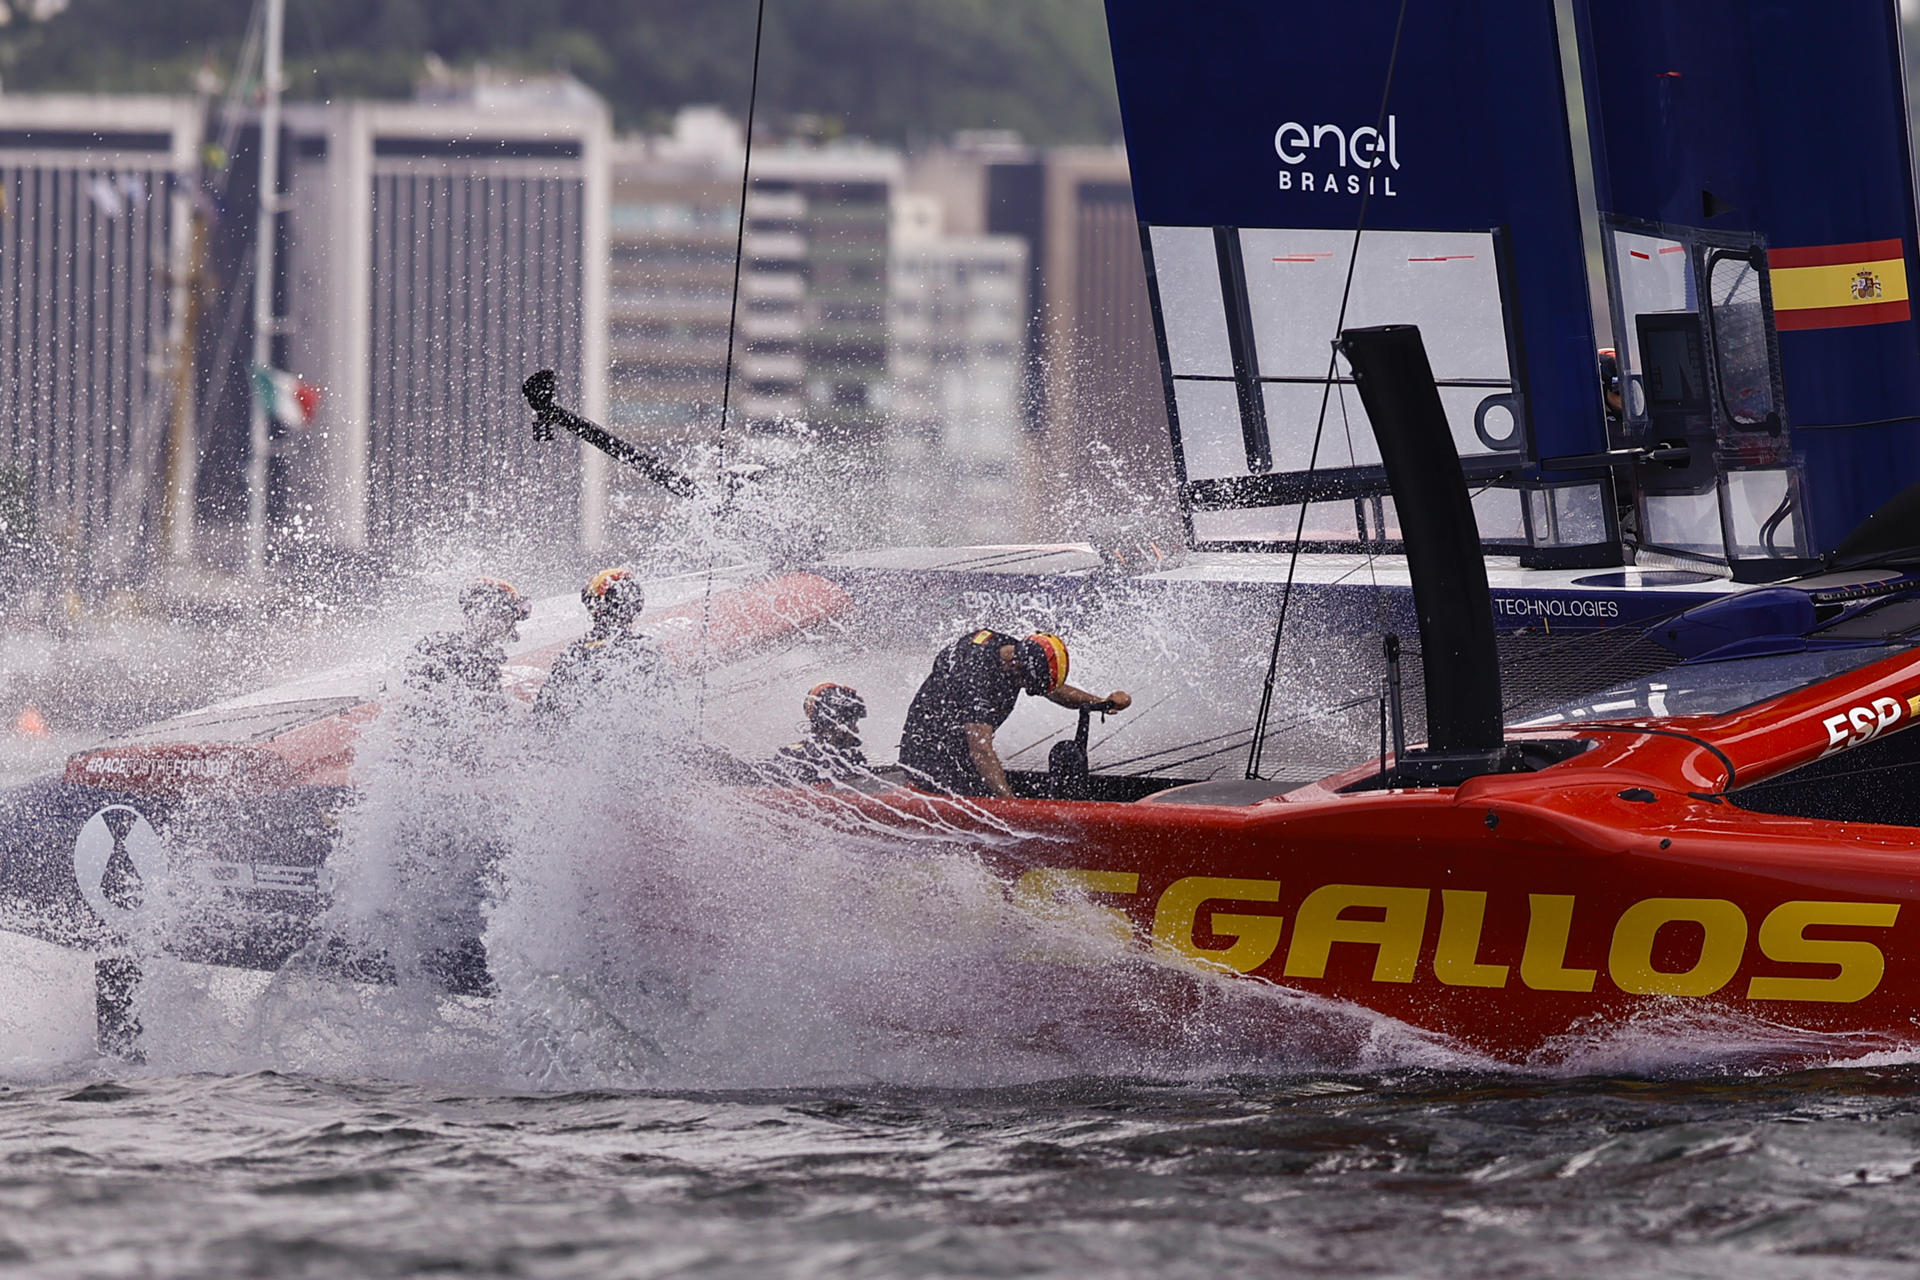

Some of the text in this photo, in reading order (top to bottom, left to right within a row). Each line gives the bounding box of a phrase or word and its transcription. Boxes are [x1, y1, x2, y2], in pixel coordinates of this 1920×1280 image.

[1274, 115, 1400, 170] enel
[1279, 170, 1397, 196] BRASIL
[1494, 598, 1619, 618] TECHNOLOGIES
[1817, 696, 1902, 759] ESP
[1151, 875, 1902, 1003] GALLOS
